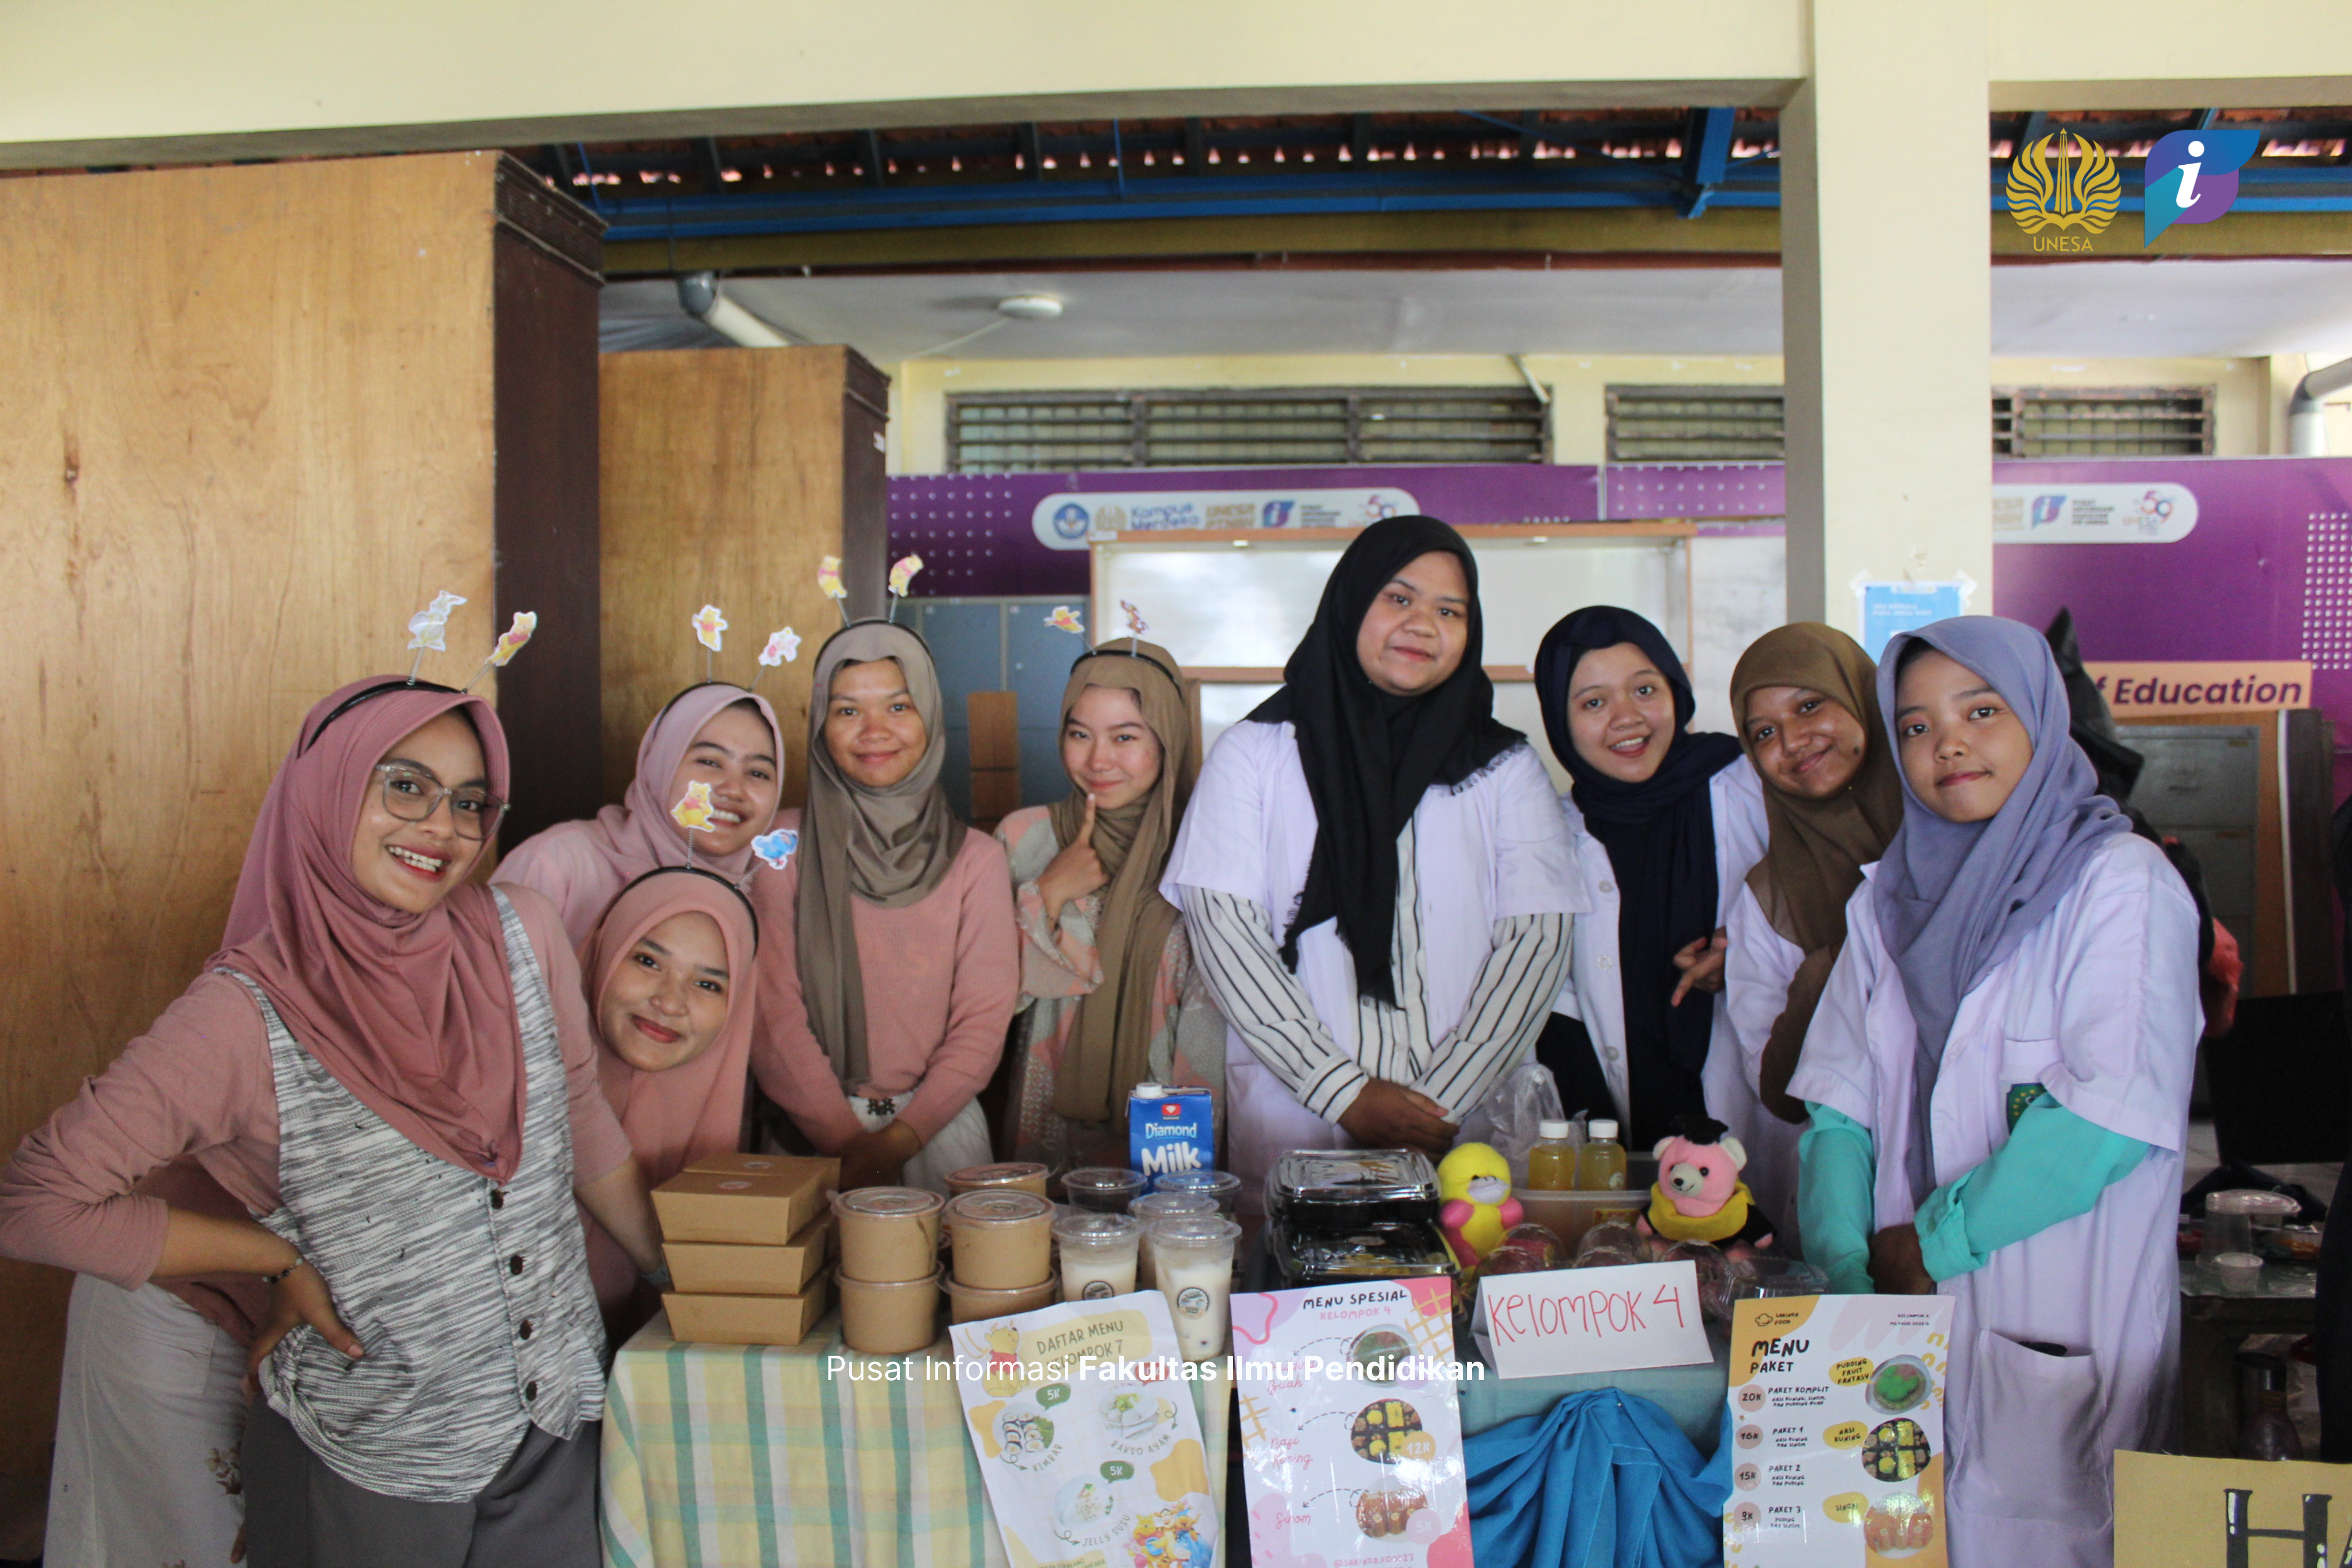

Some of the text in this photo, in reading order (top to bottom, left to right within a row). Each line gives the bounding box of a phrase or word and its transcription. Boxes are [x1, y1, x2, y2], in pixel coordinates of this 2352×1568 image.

[2114, 675, 2302, 705] Education
[1145, 1122, 1197, 1139] Diamond
[1141, 1141, 1201, 1176] Milk
[1303, 1289, 1407, 1309] MENU SPESIAL
[1653, 1284, 1684, 1328] 4
[1320, 1306, 1392, 1321] KELOMPOK 4
[1037, 1320, 1123, 1355] DAFTAR MENU
[1115, 1339, 1123, 1354] 7
[1751, 1338, 1809, 1357] MENU
[1750, 1361, 1794, 1373] PAKET
[1837, 1358, 1867, 1370] PUDDING
[1838, 1373, 1869, 1385] FANTASY
[1842, 1367, 1862, 1377] FRUIT
[1047, 1388, 1060, 1401] 5K
[1742, 1393, 1761, 1401] 20K
[1834, 1433, 1861, 1443] KUNING
[1839, 1427, 1855, 1436] NASI
[1111, 1434, 1171, 1455] BAKSO AYAM
[1406, 1441, 1430, 1455] 12K
[1110, 1466, 1123, 1476] 5K
[1739, 1471, 1756, 1480] 15K
[1082, 1514, 1131, 1547] JELLY SUSU
[2224, 1488, 2352, 1568] H
